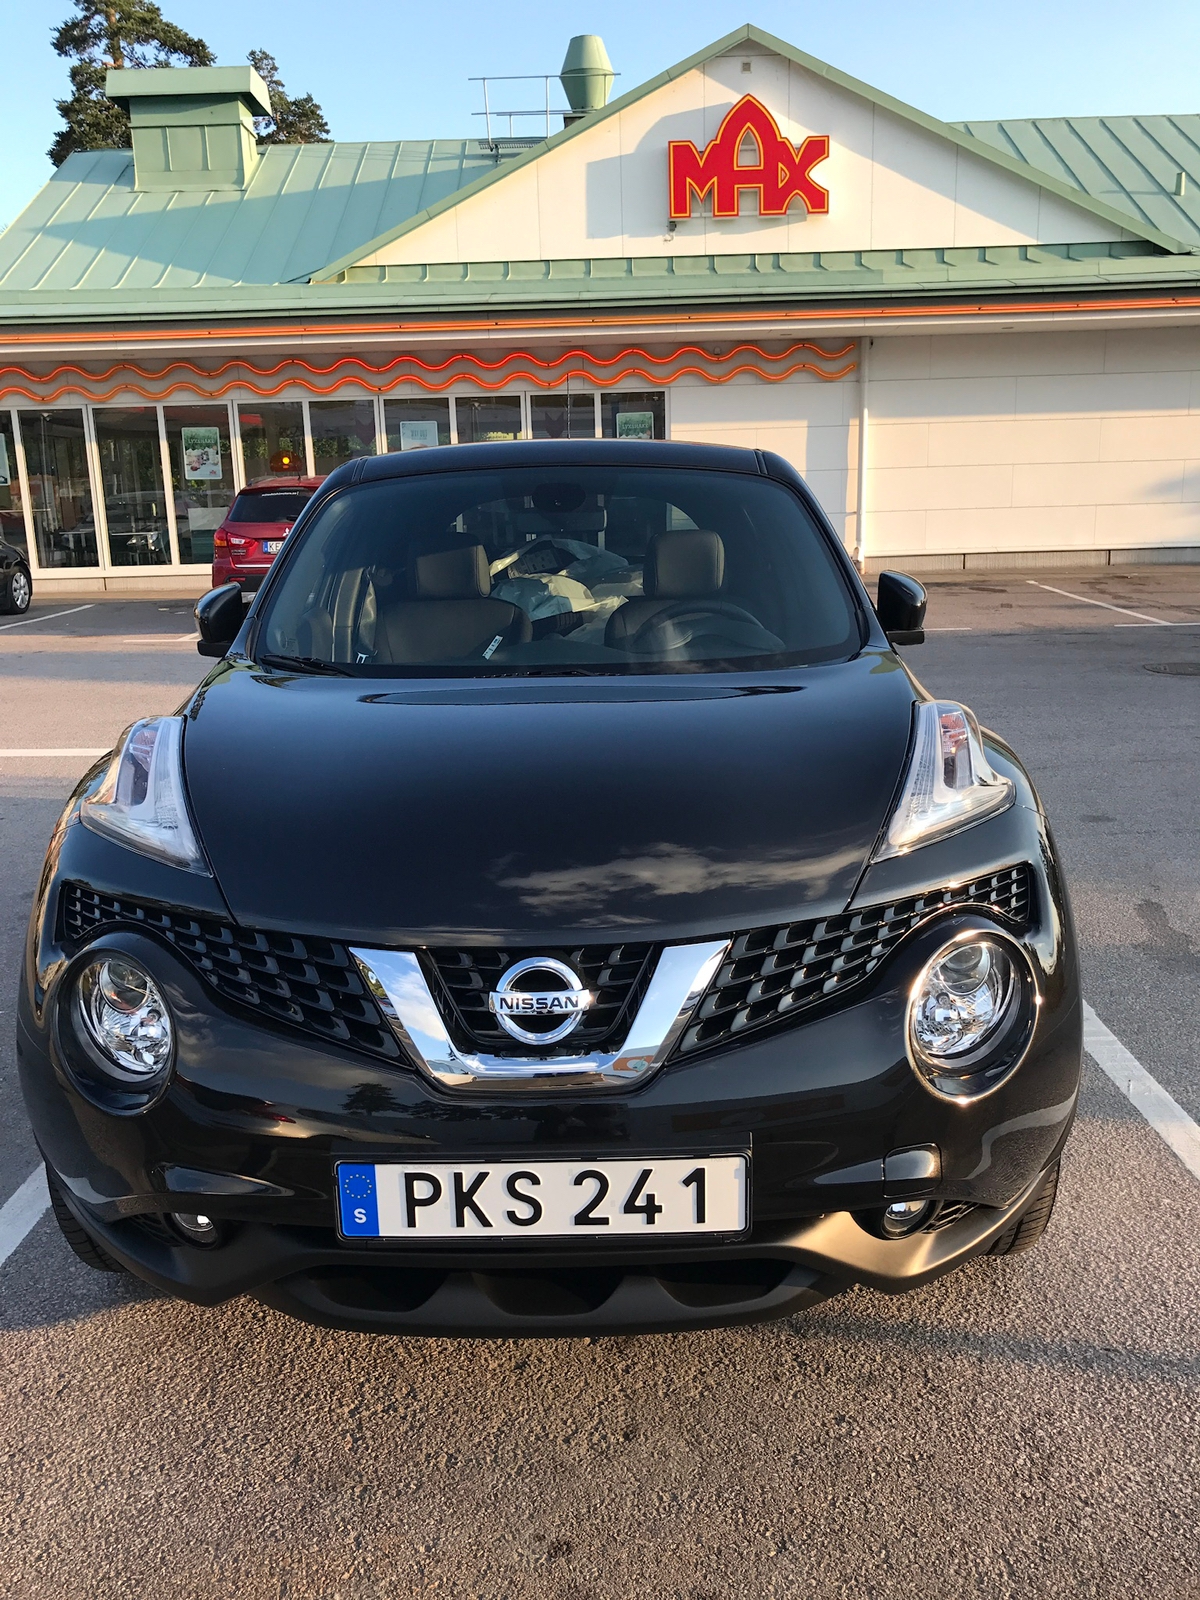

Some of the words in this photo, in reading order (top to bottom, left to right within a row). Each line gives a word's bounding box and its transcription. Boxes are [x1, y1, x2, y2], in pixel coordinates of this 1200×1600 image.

[668, 93, 830, 218] MAX
[268, 542, 284, 551] KE
[499, 995, 579, 1010] NISSAN
[403, 1170, 543, 1228] PKS
[573, 1167, 707, 1226] 241
[353, 1207, 368, 1224] S
